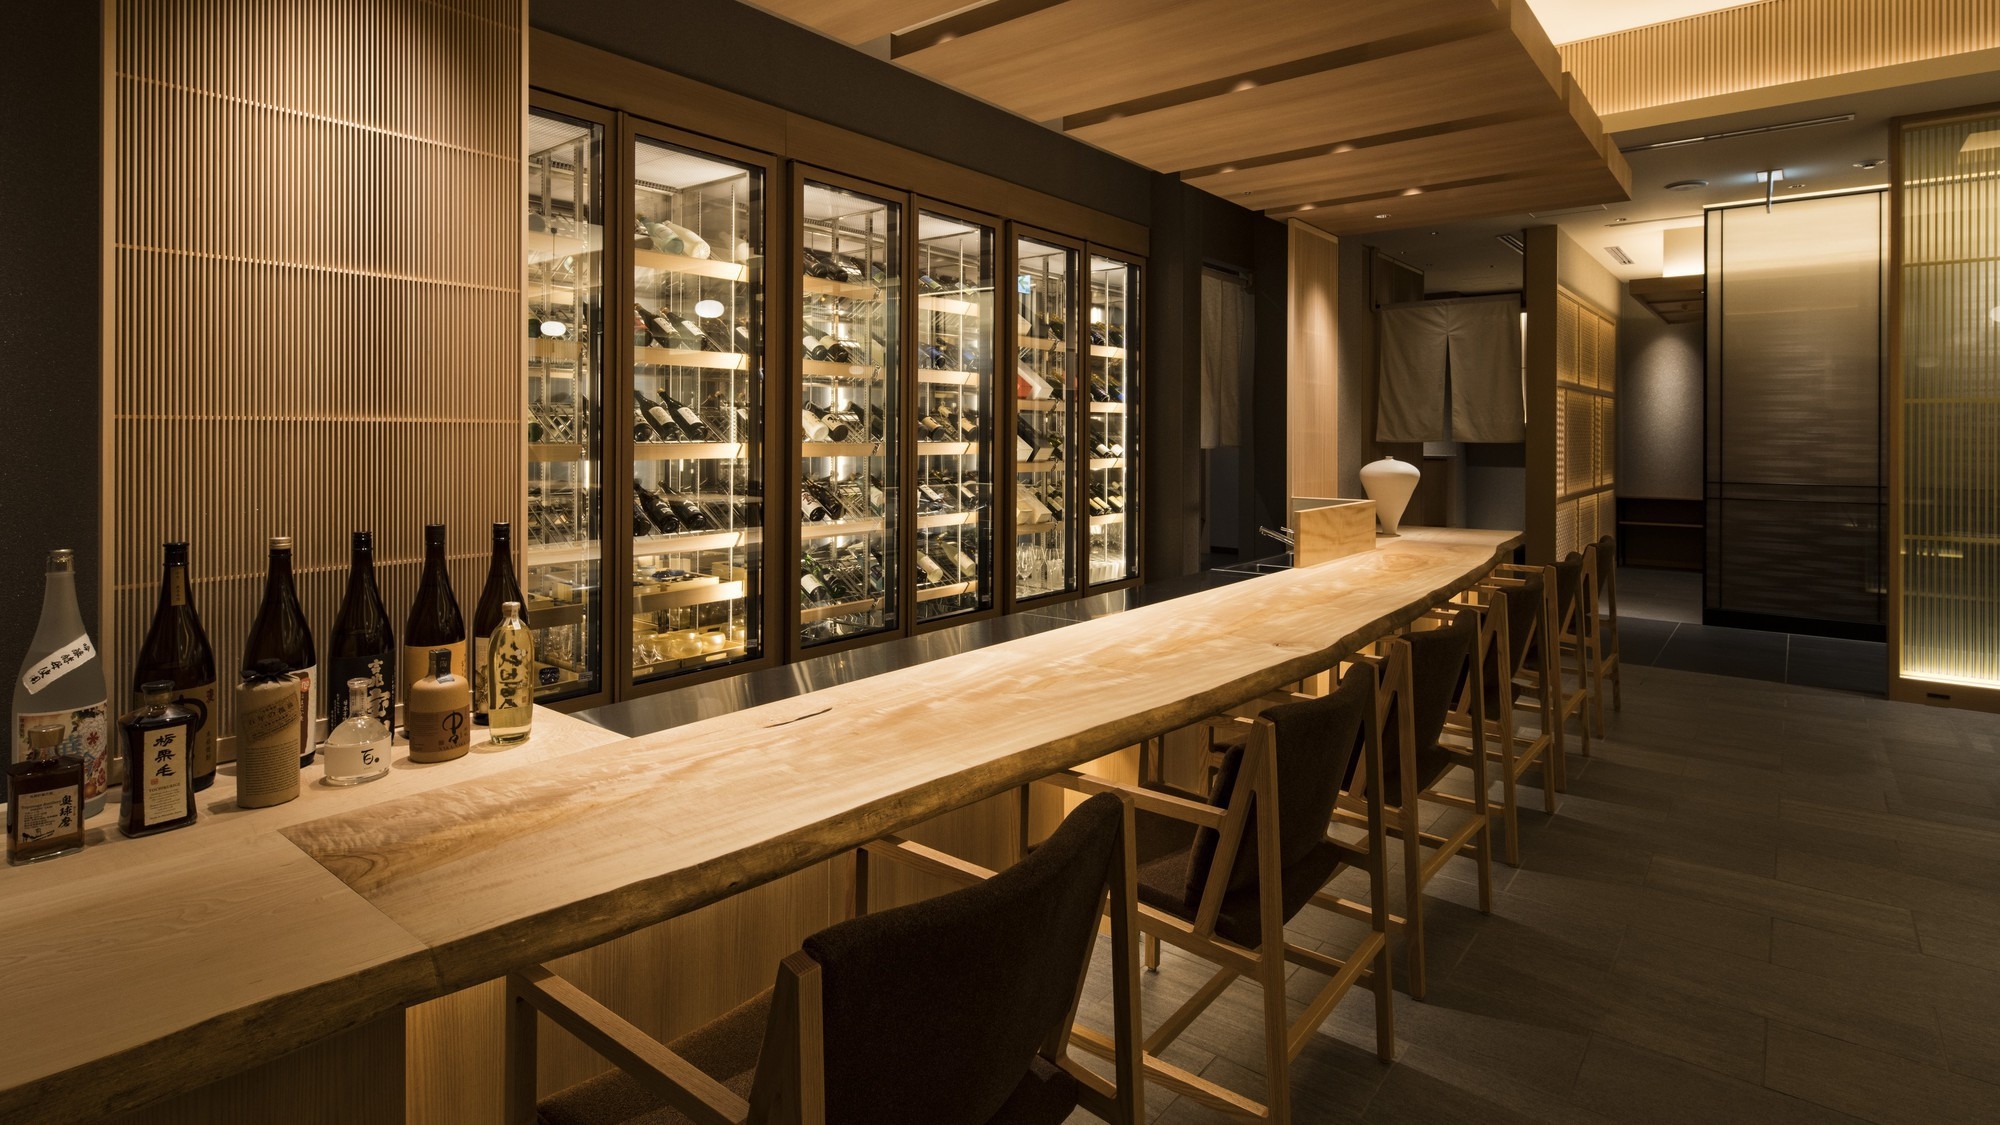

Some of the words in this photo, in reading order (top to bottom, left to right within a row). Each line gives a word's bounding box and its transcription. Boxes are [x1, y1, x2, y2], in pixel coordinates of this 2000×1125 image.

[153, 733, 176, 777] 栃栗毛
[58, 794, 73, 829] 奥球磨
